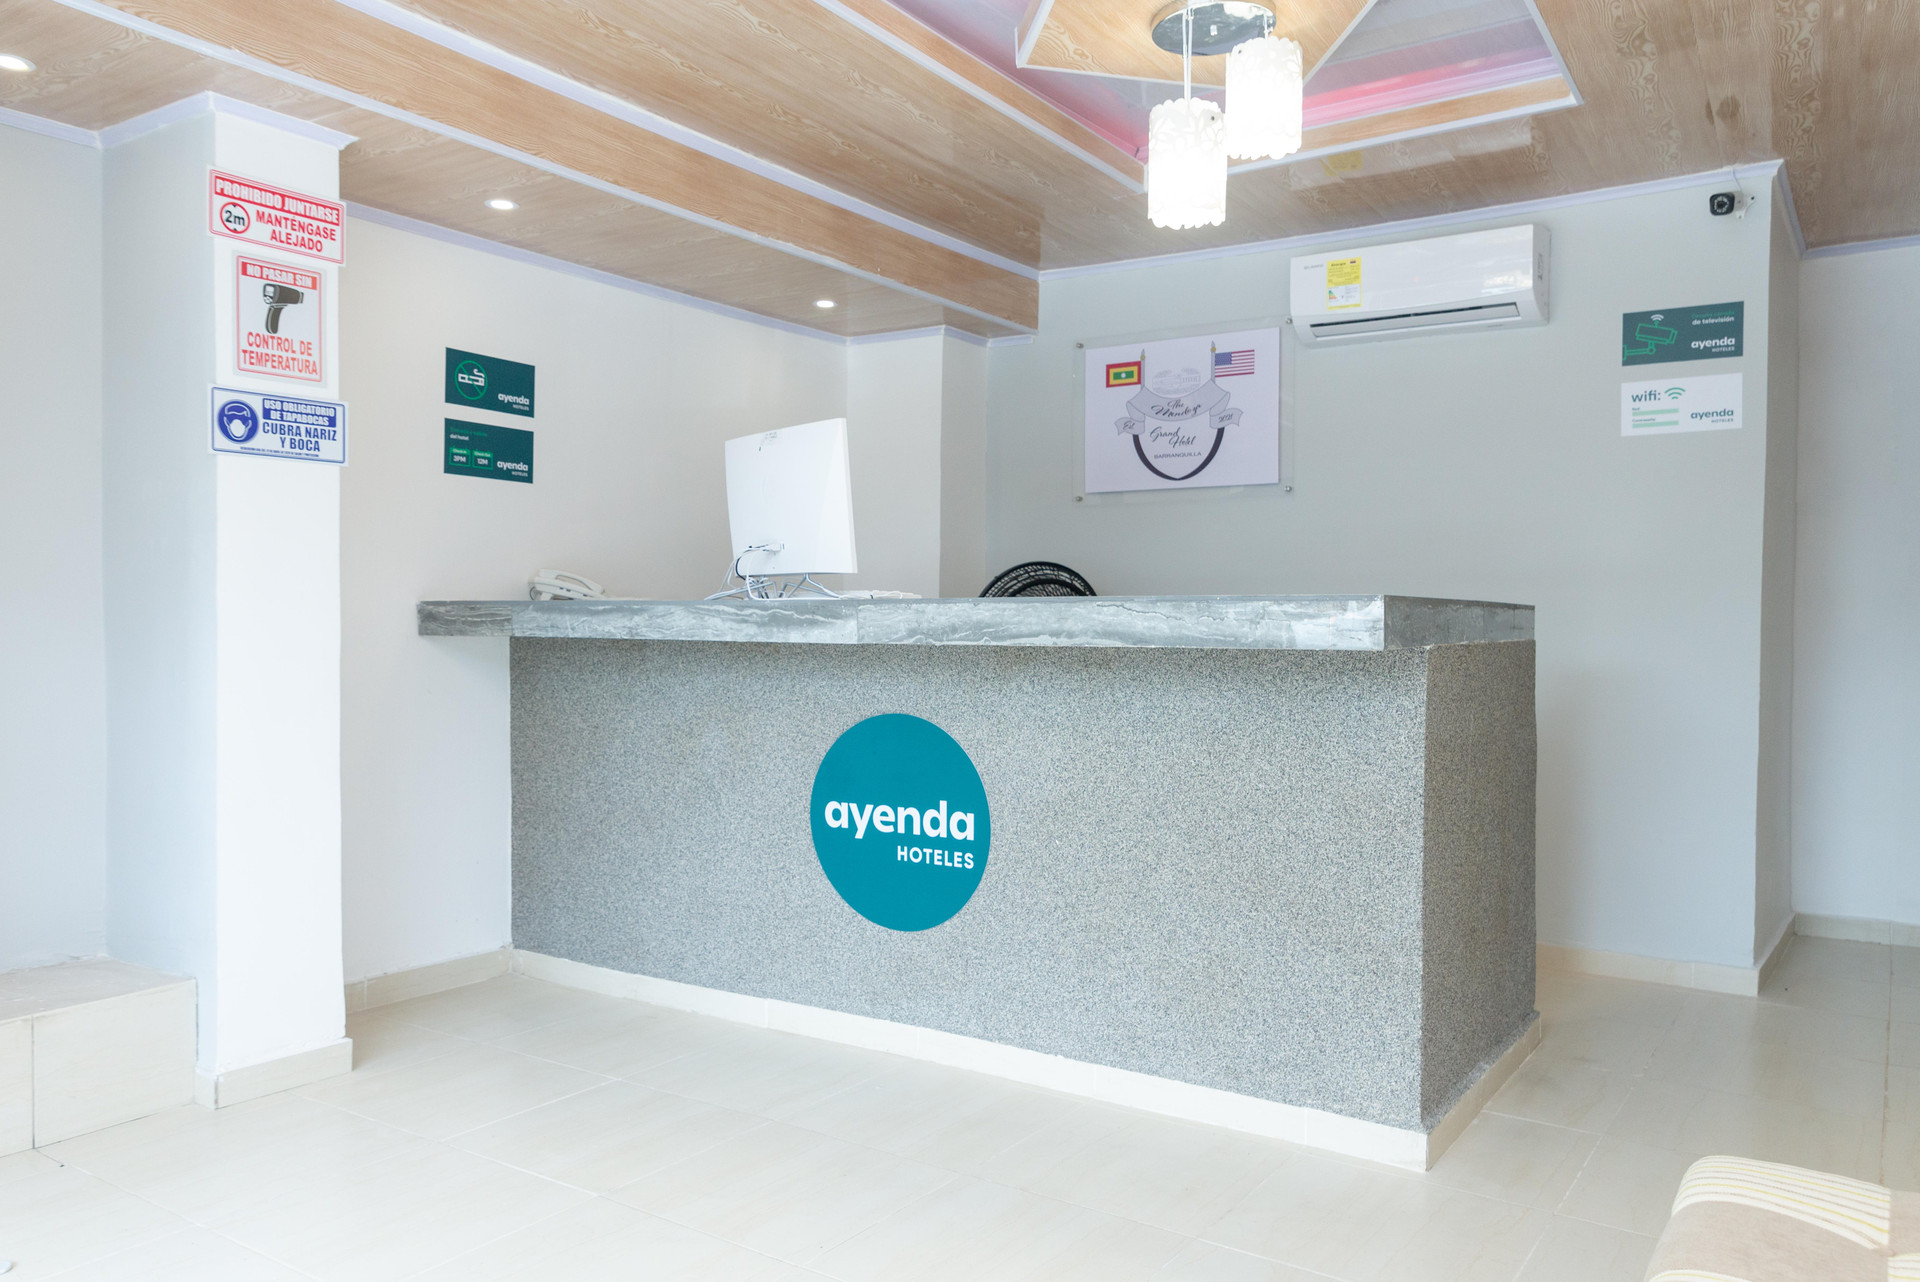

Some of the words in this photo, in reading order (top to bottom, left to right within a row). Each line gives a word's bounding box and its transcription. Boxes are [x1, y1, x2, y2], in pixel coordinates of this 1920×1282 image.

[215, 178, 283, 209] PROHIBIDO
[284, 197, 339, 222] JUNTARSE
[224, 210, 245, 226] 2m
[270, 229, 323, 252] ALEJADO
[246, 263, 261, 277] NO
[262, 267, 294, 284] PASAR
[295, 274, 312, 288] SIN
[1702, 316, 1734, 324] televisión
[247, 331, 296, 354] CONTROL
[299, 340, 312, 356] DE
[1691, 336, 1735, 350] ayenda
[241, 349, 318, 375] TEMPERATURA
[498, 393, 530, 405] ayenda
[264, 399, 281, 410] USO
[282, 401, 335, 417] OBLIGATORIO
[1690, 408, 1734, 421] ayenda
[270, 410, 282, 420] DE
[283, 411, 329, 426] TAPABOCAS
[262, 421, 301, 438] CUBRA
[305, 426, 337, 441] NARIZ
[1149, 426, 1181, 443] Grand
[280, 437, 287, 448] Y
[290, 438, 320, 452] BOCA
[1168, 435, 1197, 449] Hotel
[497, 460, 528, 471] ayenda
[824, 800, 975, 841] ayenda
[897, 845, 974, 869] HOTELES
